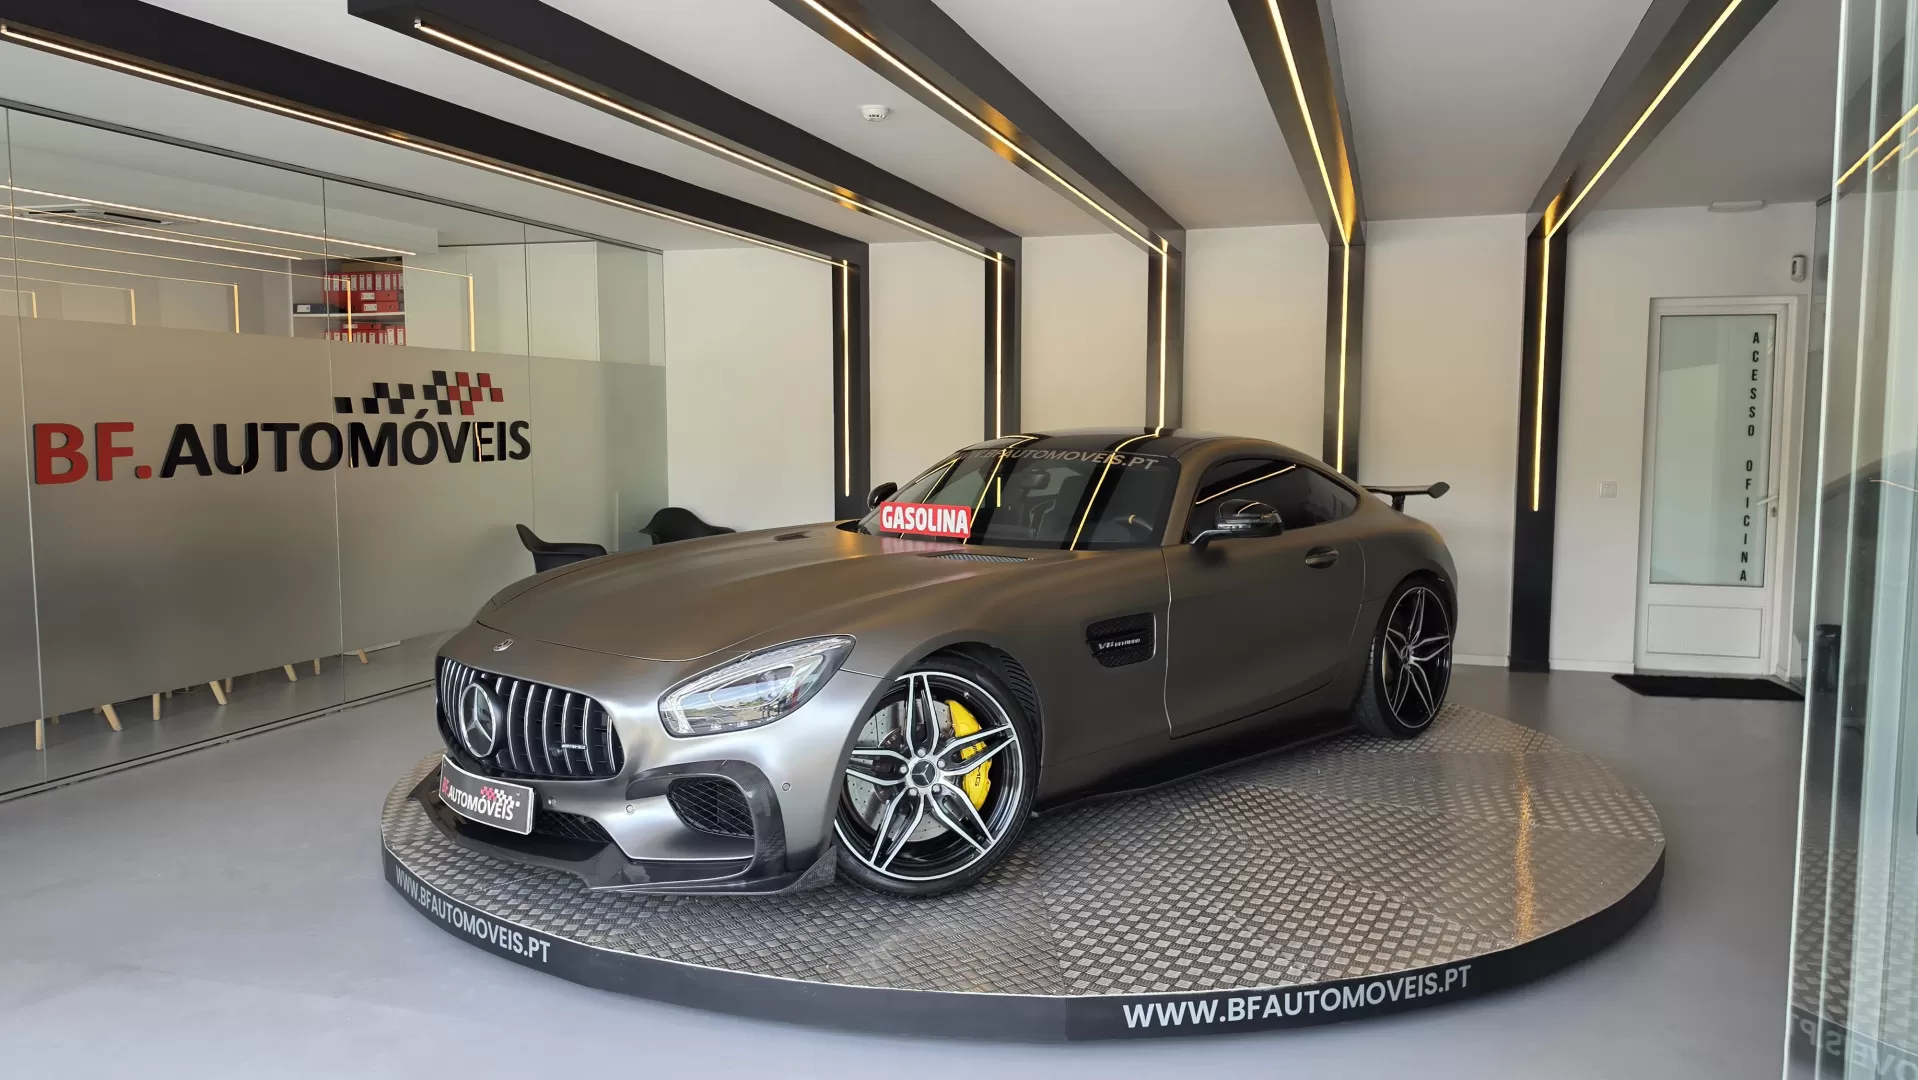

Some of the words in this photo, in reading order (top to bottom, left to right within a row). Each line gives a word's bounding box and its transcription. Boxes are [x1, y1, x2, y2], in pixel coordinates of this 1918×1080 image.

[1747, 331, 1760, 437] ACESSO
[33, 408, 531, 484] BF.AUTOMÓVEIS
[881, 505, 969, 535] GASOLINA
[1739, 459, 1753, 582] OFICINA
[395, 865, 551, 963] WWW.BFAUTOMOVEIS.PT
[1122, 964, 1472, 1029] WWW.BFAUTOMOVEIS.PT
